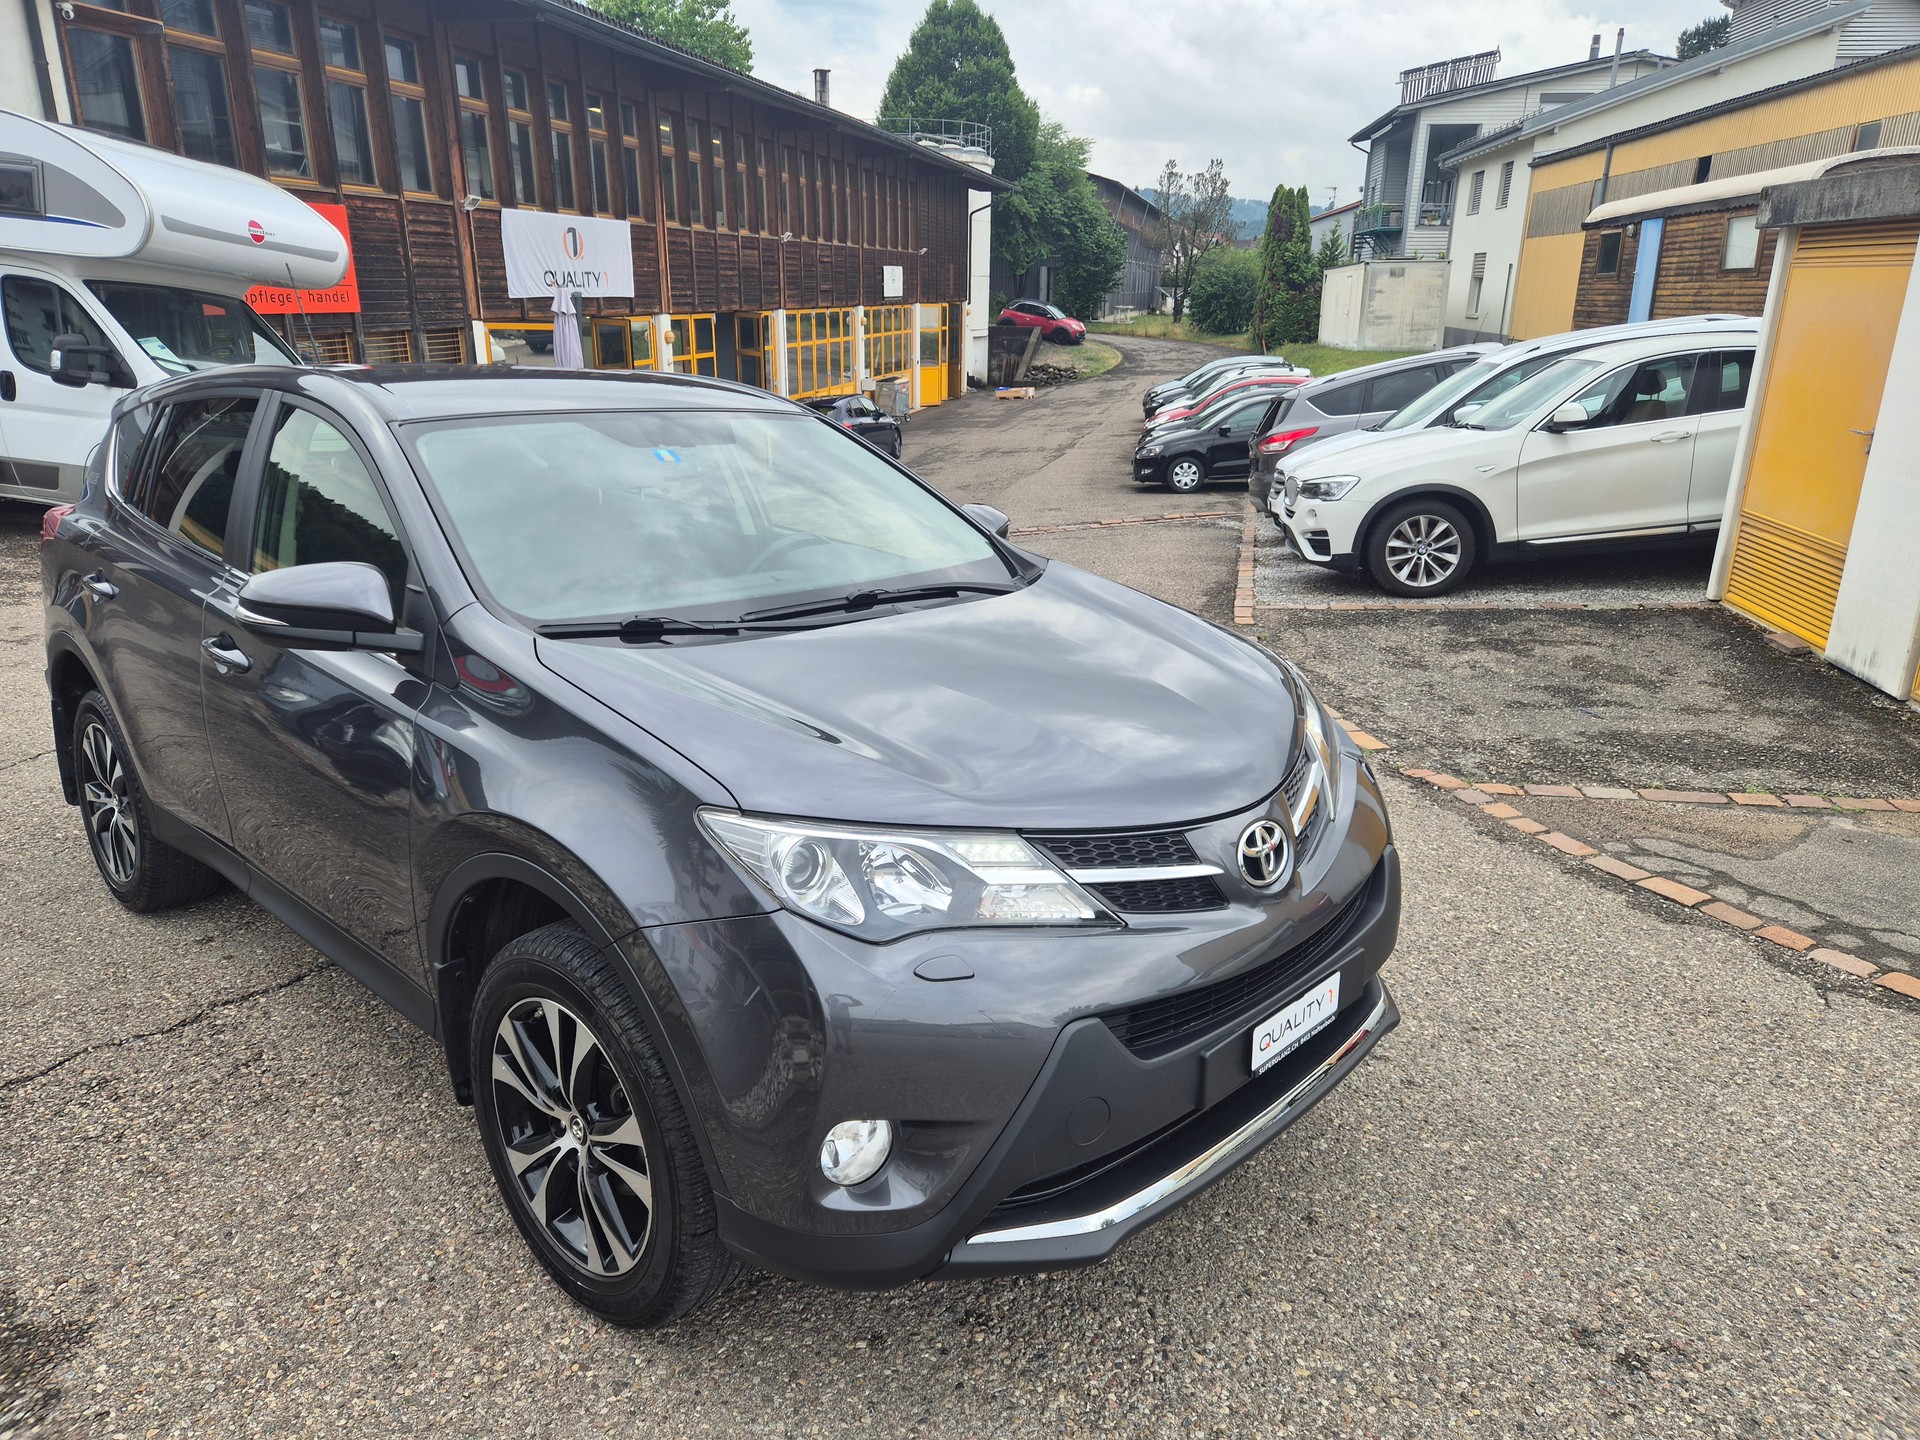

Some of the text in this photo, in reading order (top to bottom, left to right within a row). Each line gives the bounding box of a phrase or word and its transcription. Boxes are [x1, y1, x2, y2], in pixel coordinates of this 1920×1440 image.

[543, 269, 601, 288] QUALITY
[307, 290, 350, 303] handel
[1259, 989, 1334, 1052] QUALITY 1
